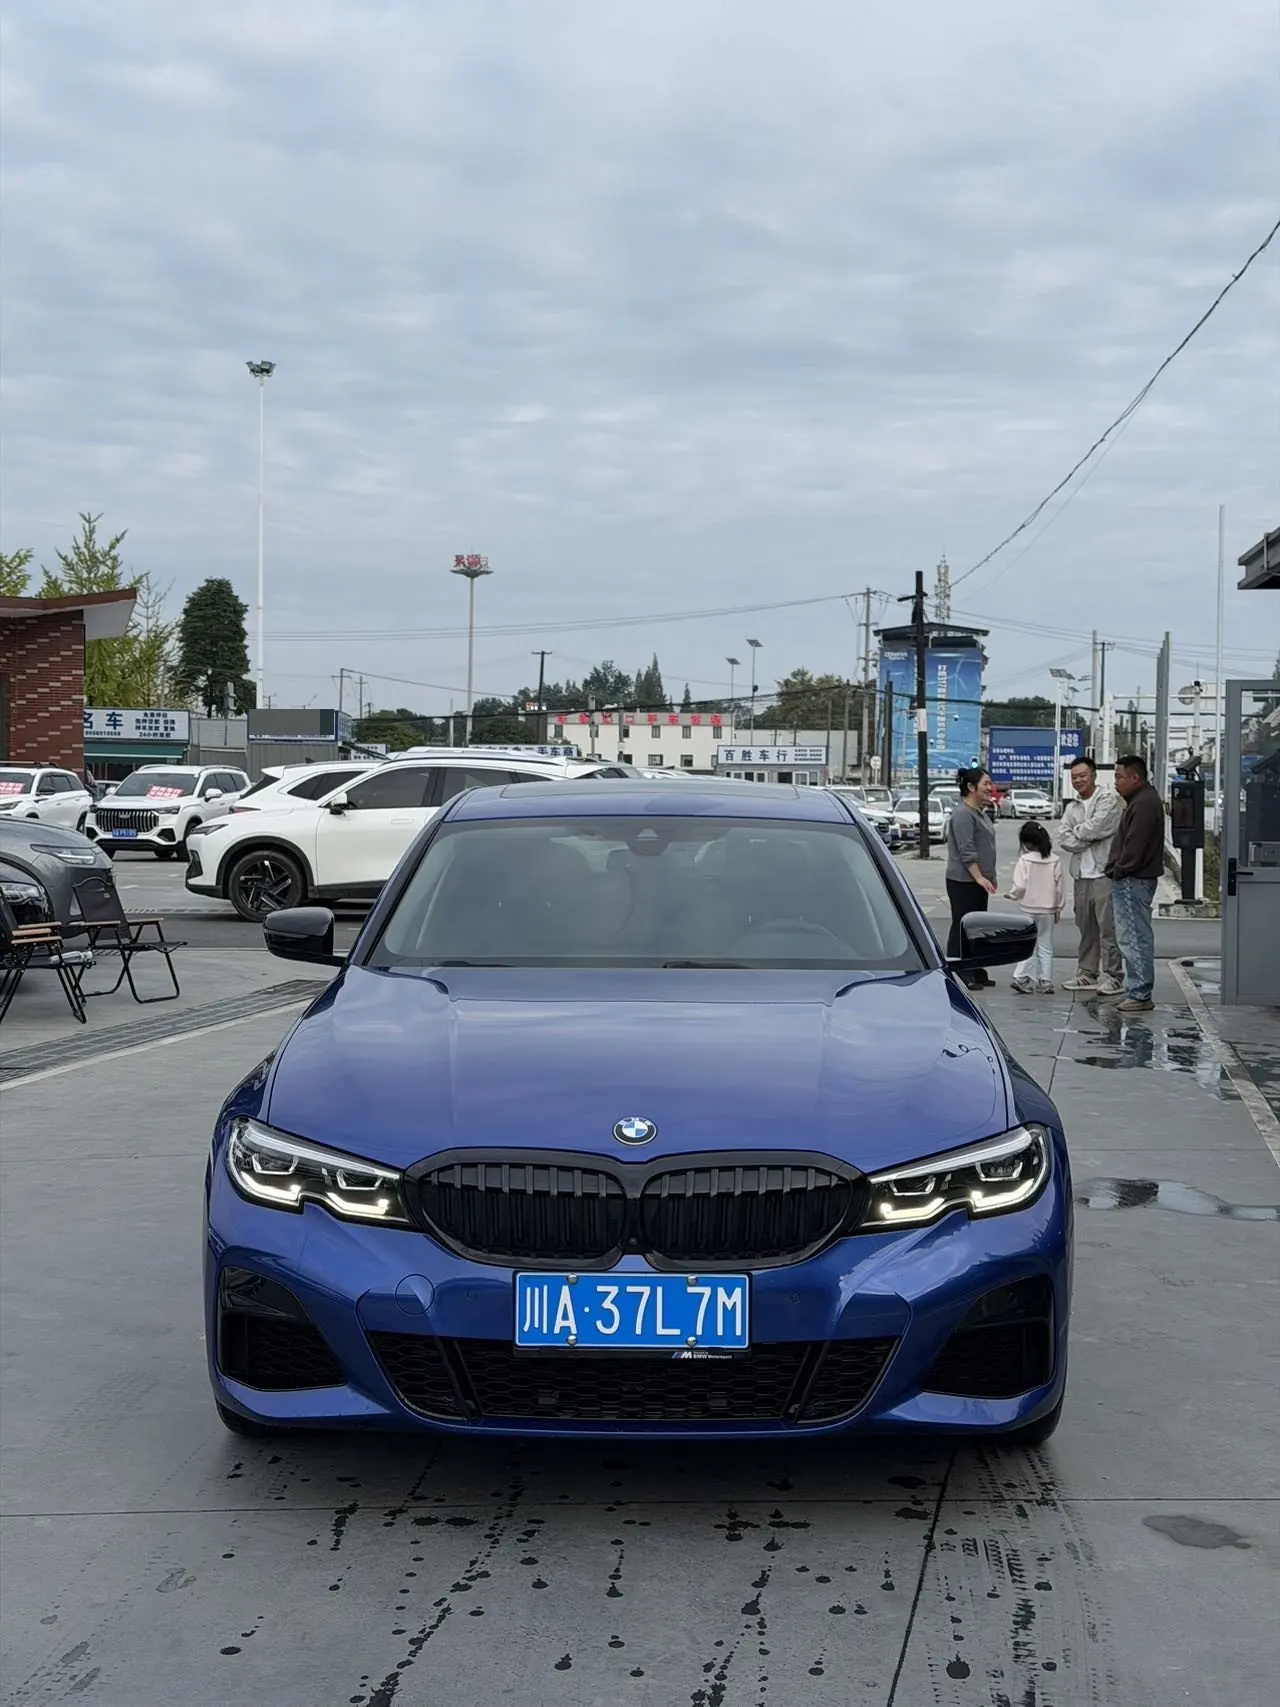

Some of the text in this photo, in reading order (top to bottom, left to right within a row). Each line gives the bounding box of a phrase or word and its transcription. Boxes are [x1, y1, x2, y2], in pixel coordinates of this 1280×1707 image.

[724, 749, 787, 761] 百胜车行
[523, 1285, 742, 1336] 川A·37L7M
